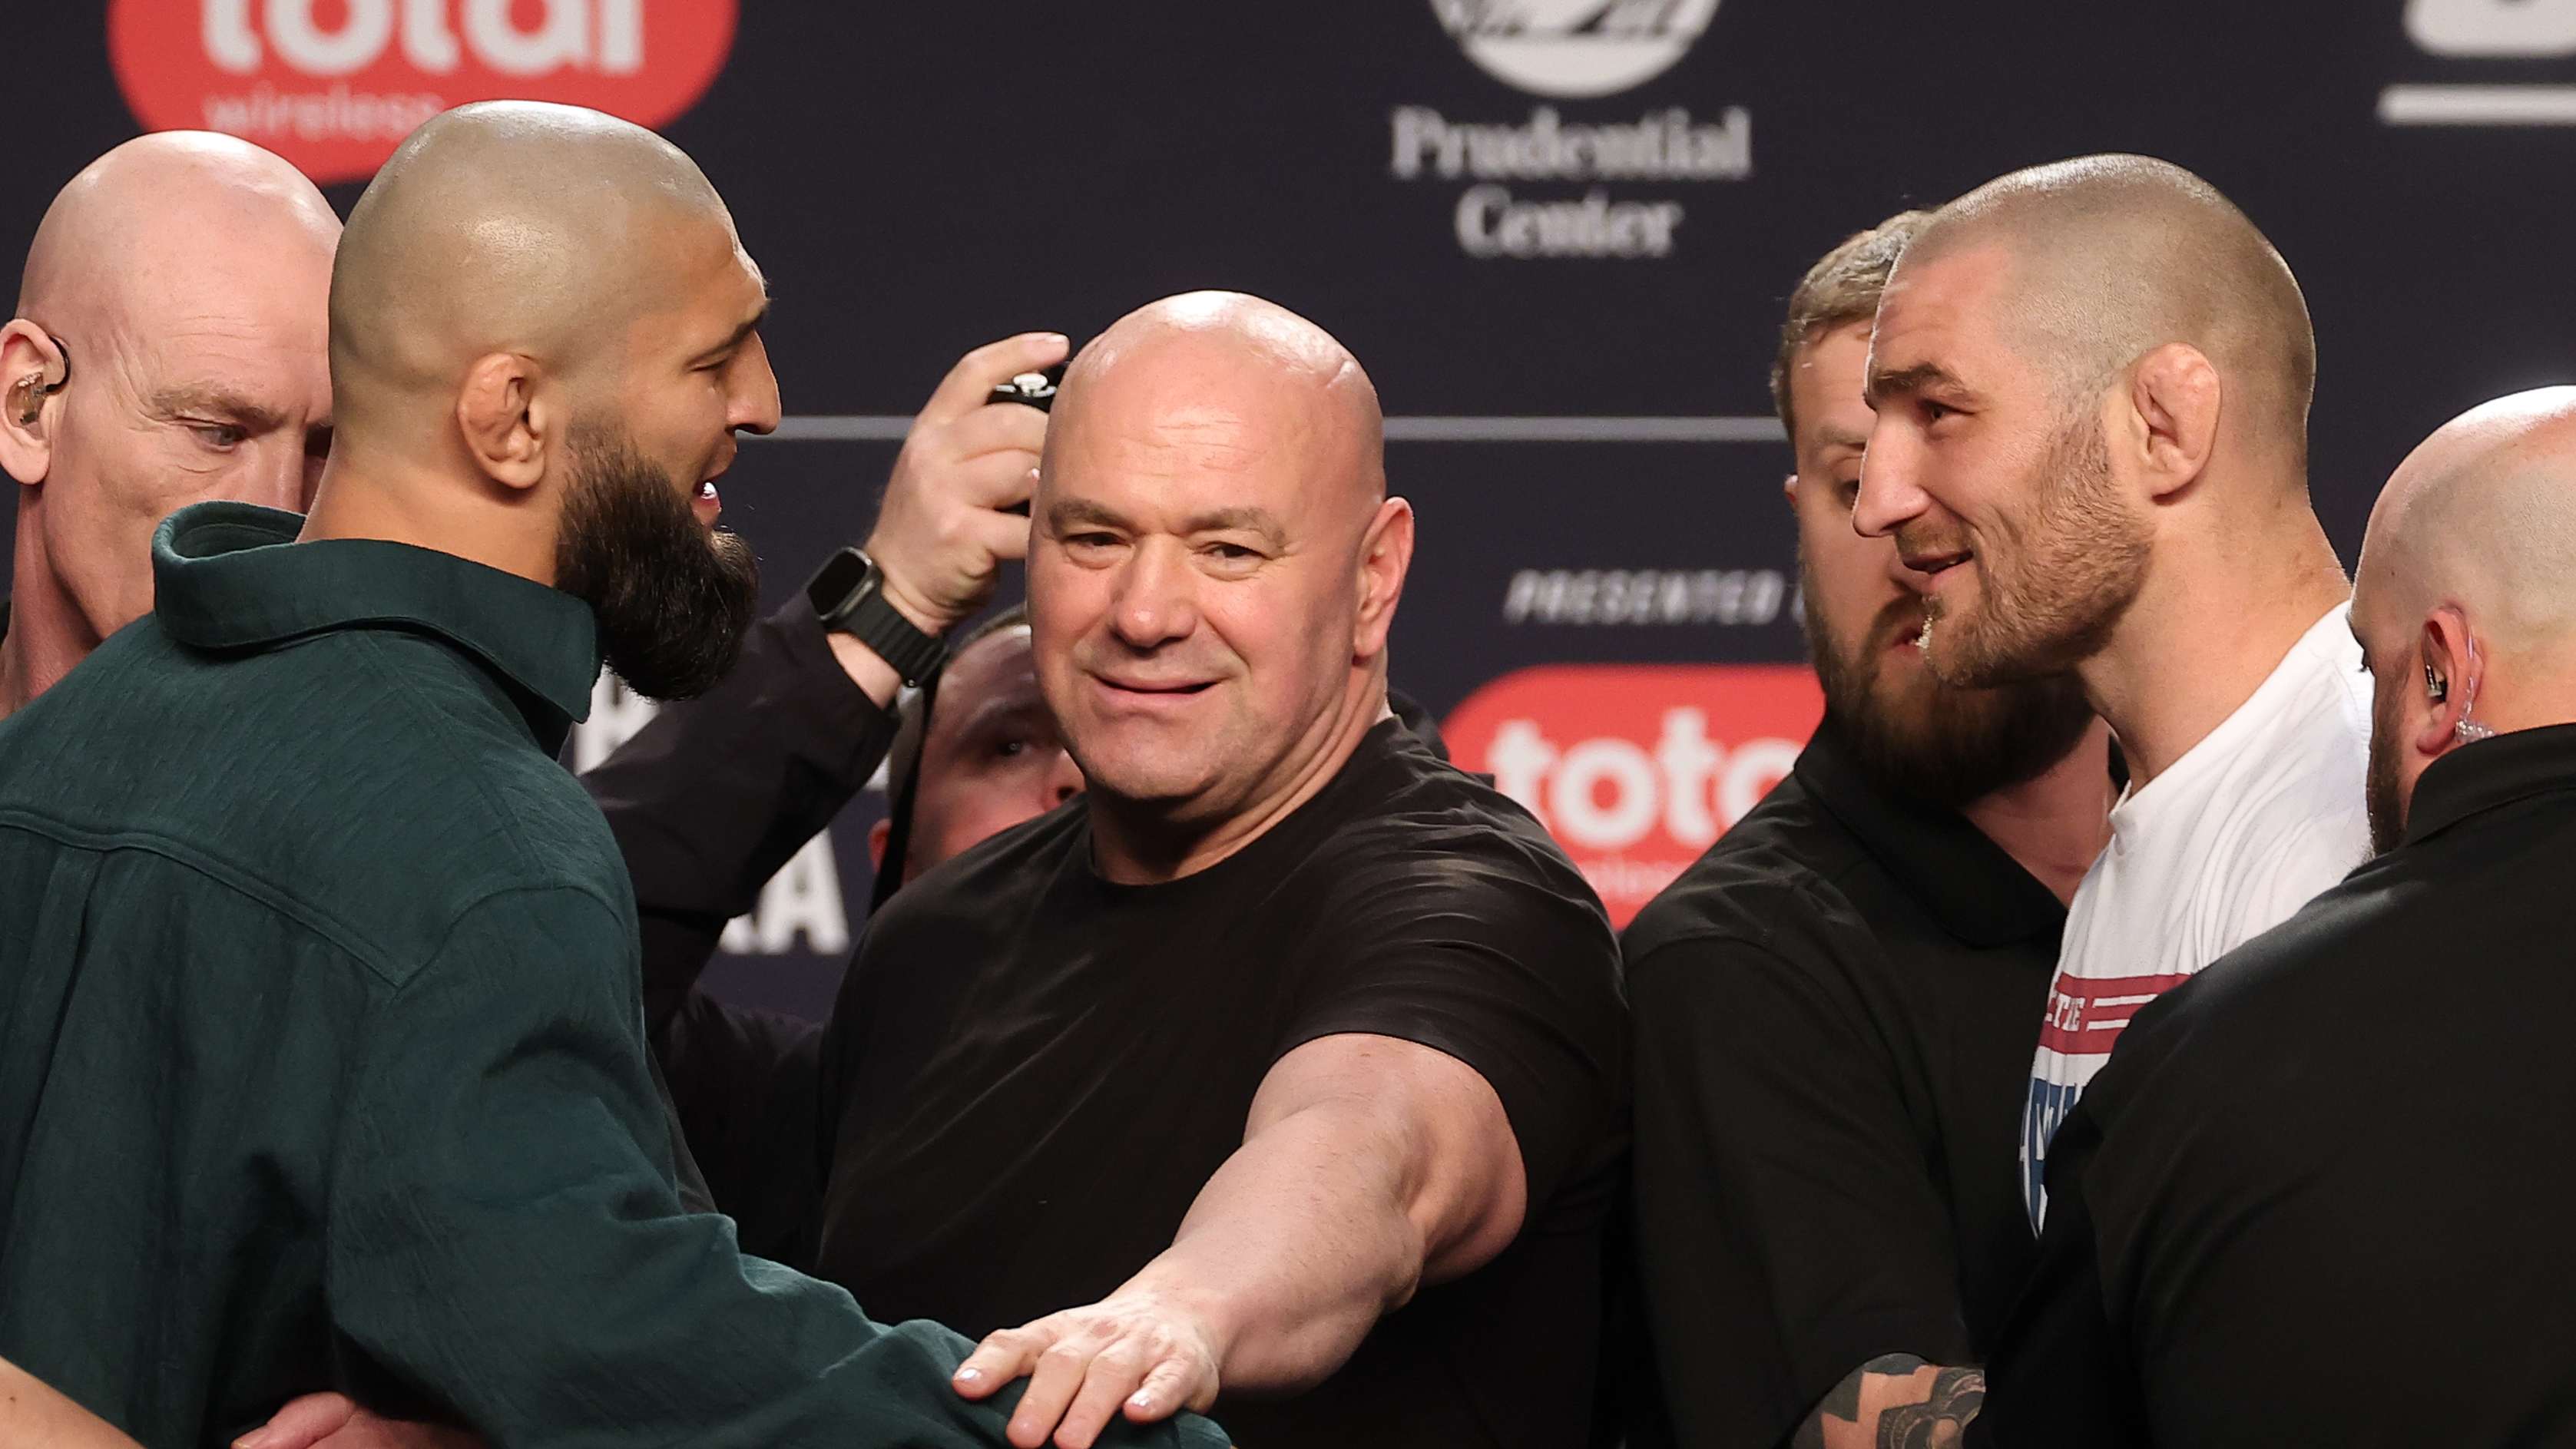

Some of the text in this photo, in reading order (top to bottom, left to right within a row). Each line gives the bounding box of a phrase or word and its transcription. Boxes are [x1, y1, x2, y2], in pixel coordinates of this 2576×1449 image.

[1392, 106, 1752, 180] Prudential
[1455, 184, 1682, 258] Center
[1502, 569, 1785, 625] PRESENTED
